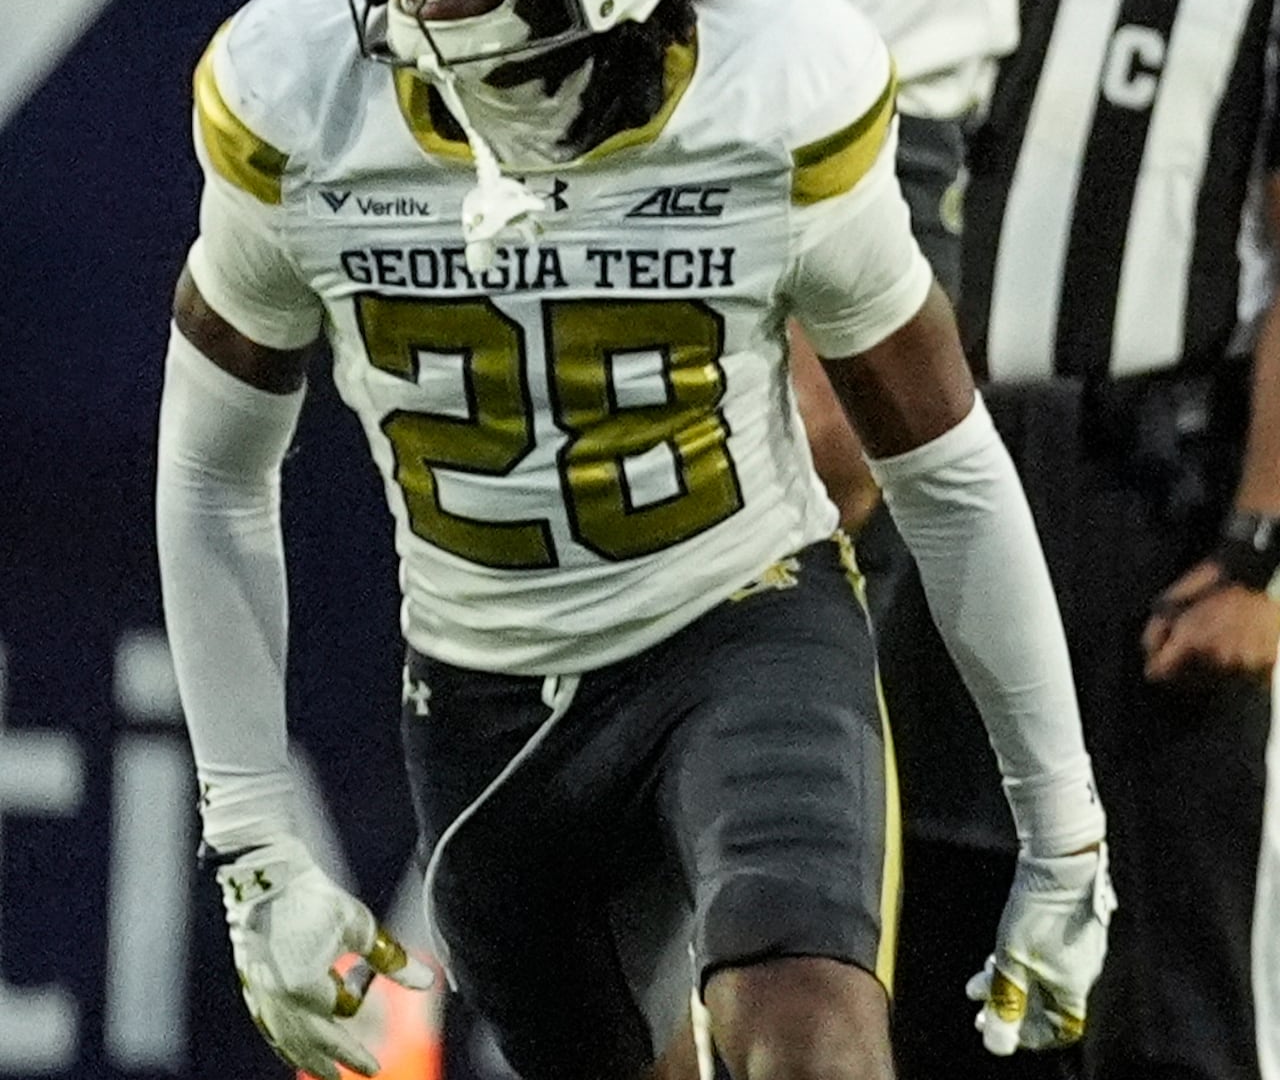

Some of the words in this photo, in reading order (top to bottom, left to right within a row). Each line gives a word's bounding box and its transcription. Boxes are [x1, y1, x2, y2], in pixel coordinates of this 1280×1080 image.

[1102, 22, 1166, 111] C
[356, 196, 431, 217] Veritiv
[626, 187, 730, 217] ACC
[586, 247, 736, 290] TECH
[354, 293, 745, 570] 28
